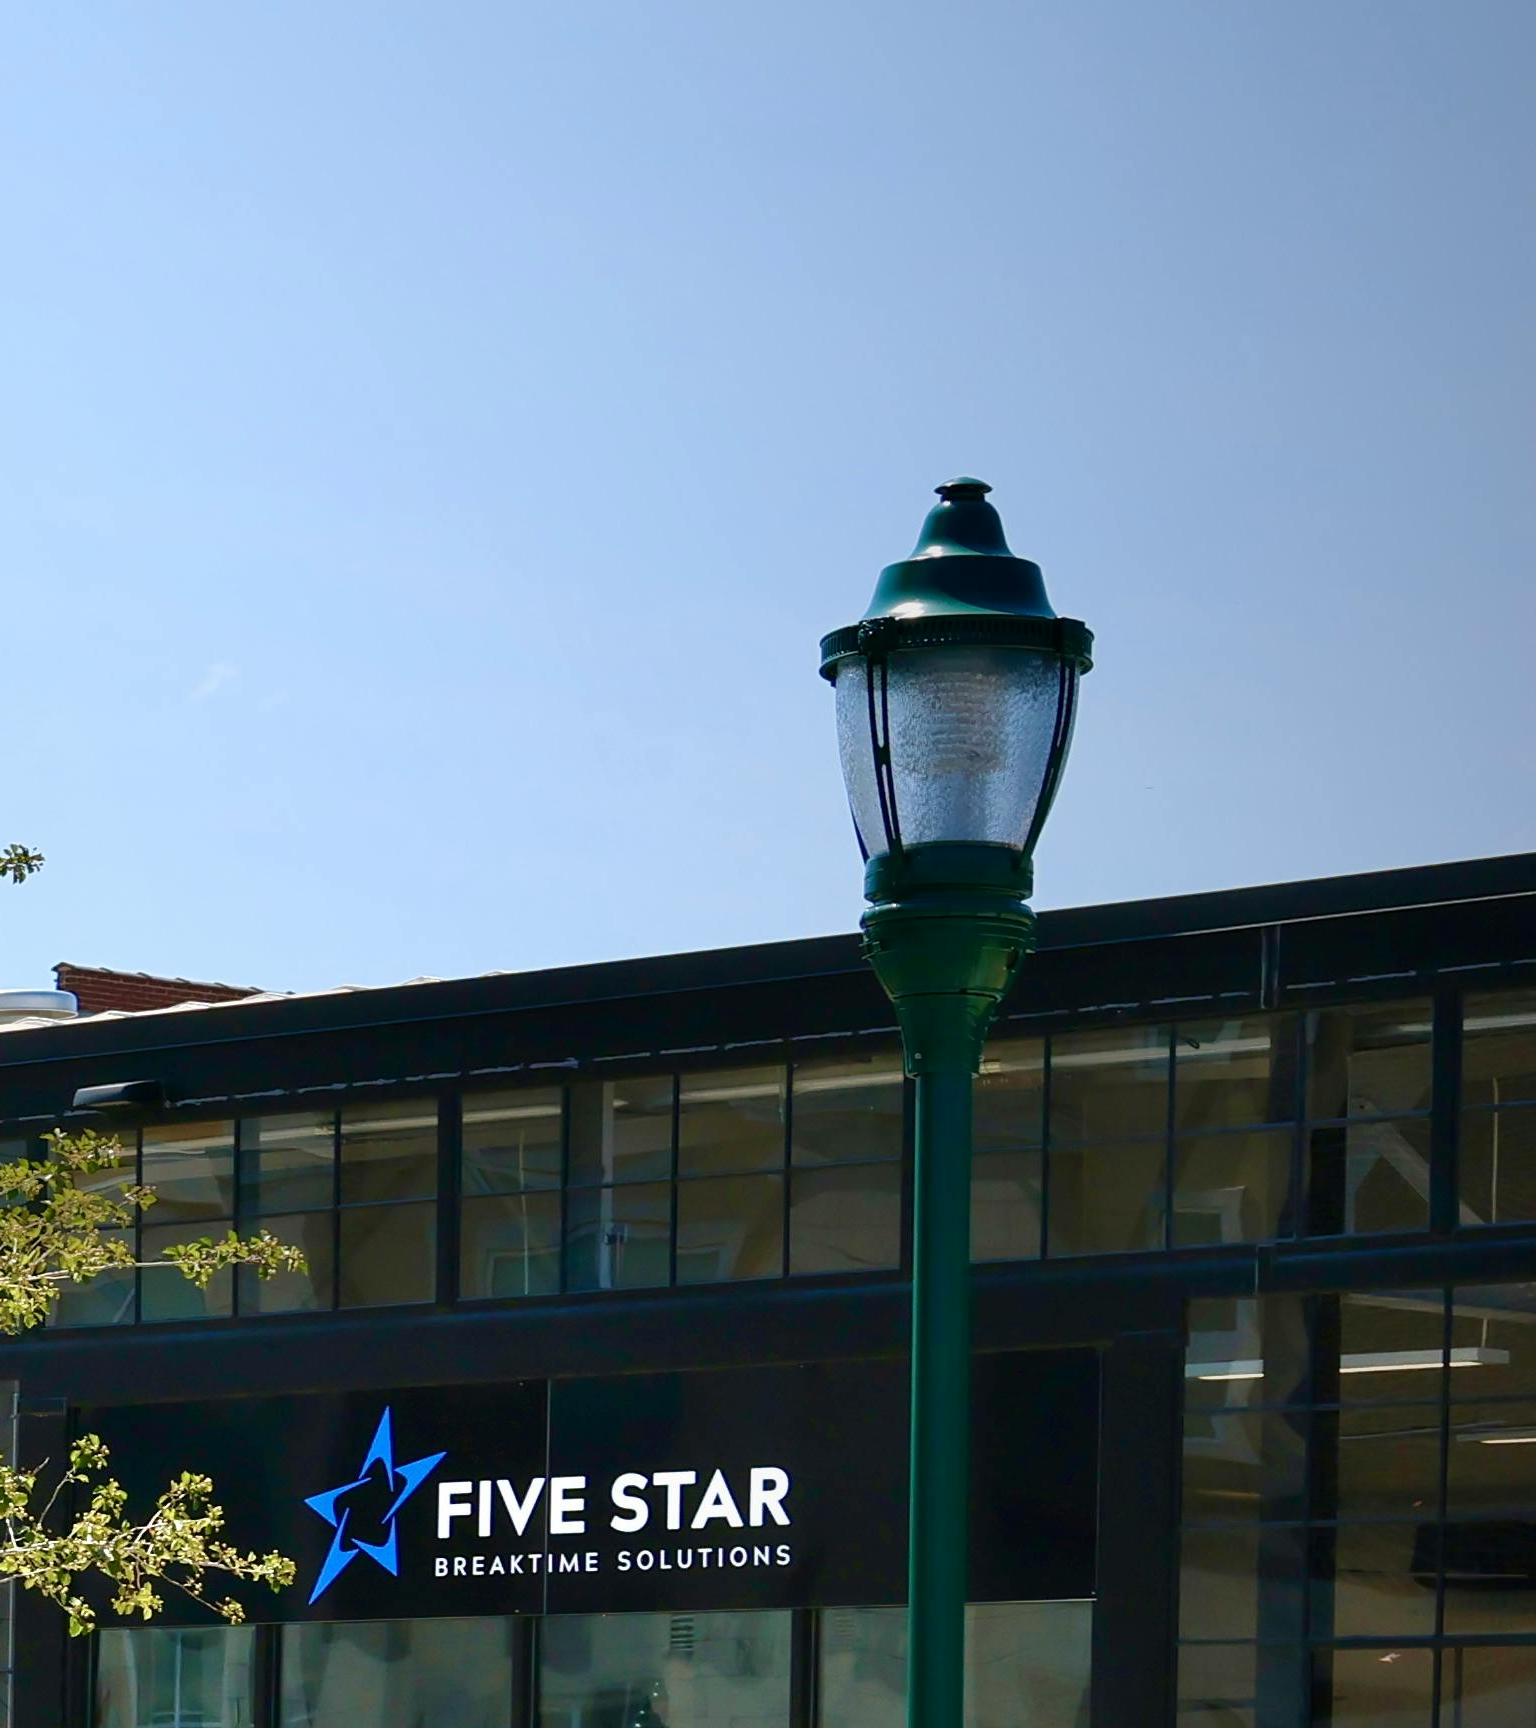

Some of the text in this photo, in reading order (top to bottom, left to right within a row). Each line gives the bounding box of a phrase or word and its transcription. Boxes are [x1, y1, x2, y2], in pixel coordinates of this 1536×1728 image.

[437, 1466, 792, 1540] FIVE STAR
[435, 1544, 792, 1578] BREAKTIME SOLUTIONS
